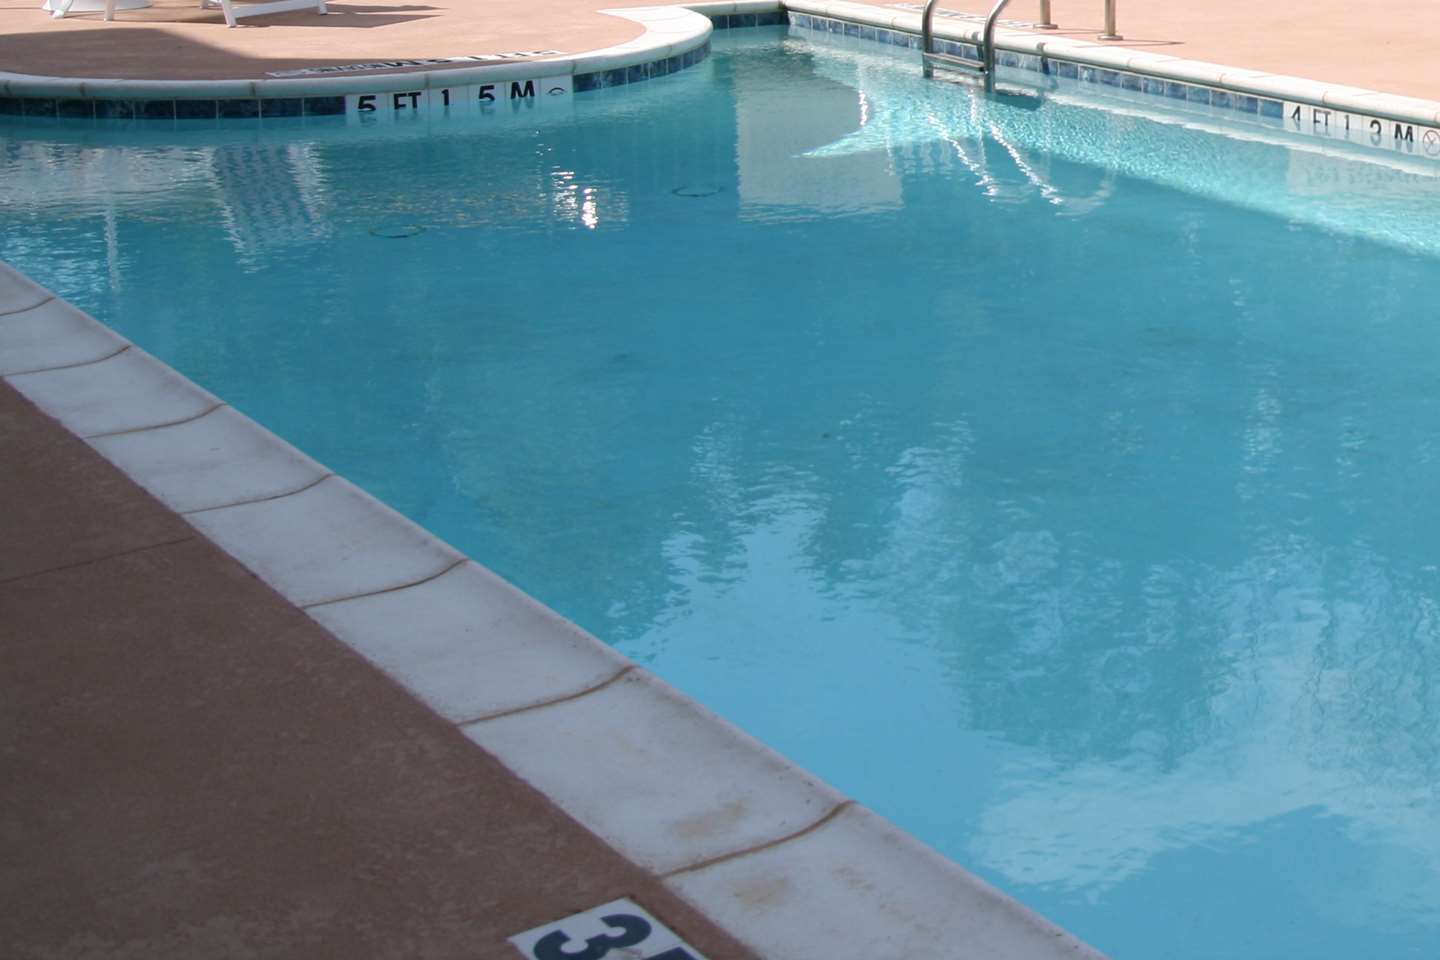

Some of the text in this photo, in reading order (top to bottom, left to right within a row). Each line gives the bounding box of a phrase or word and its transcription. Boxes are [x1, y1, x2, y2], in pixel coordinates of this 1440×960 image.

[357, 95, 377, 112] 5
[394, 92, 422, 109] FT
[478, 85, 496, 102] 5
[510, 80, 535, 99] M
[1313, 109, 1331, 126] FT
[1394, 123, 1413, 142] M
[534, 914, 653, 960] 3
